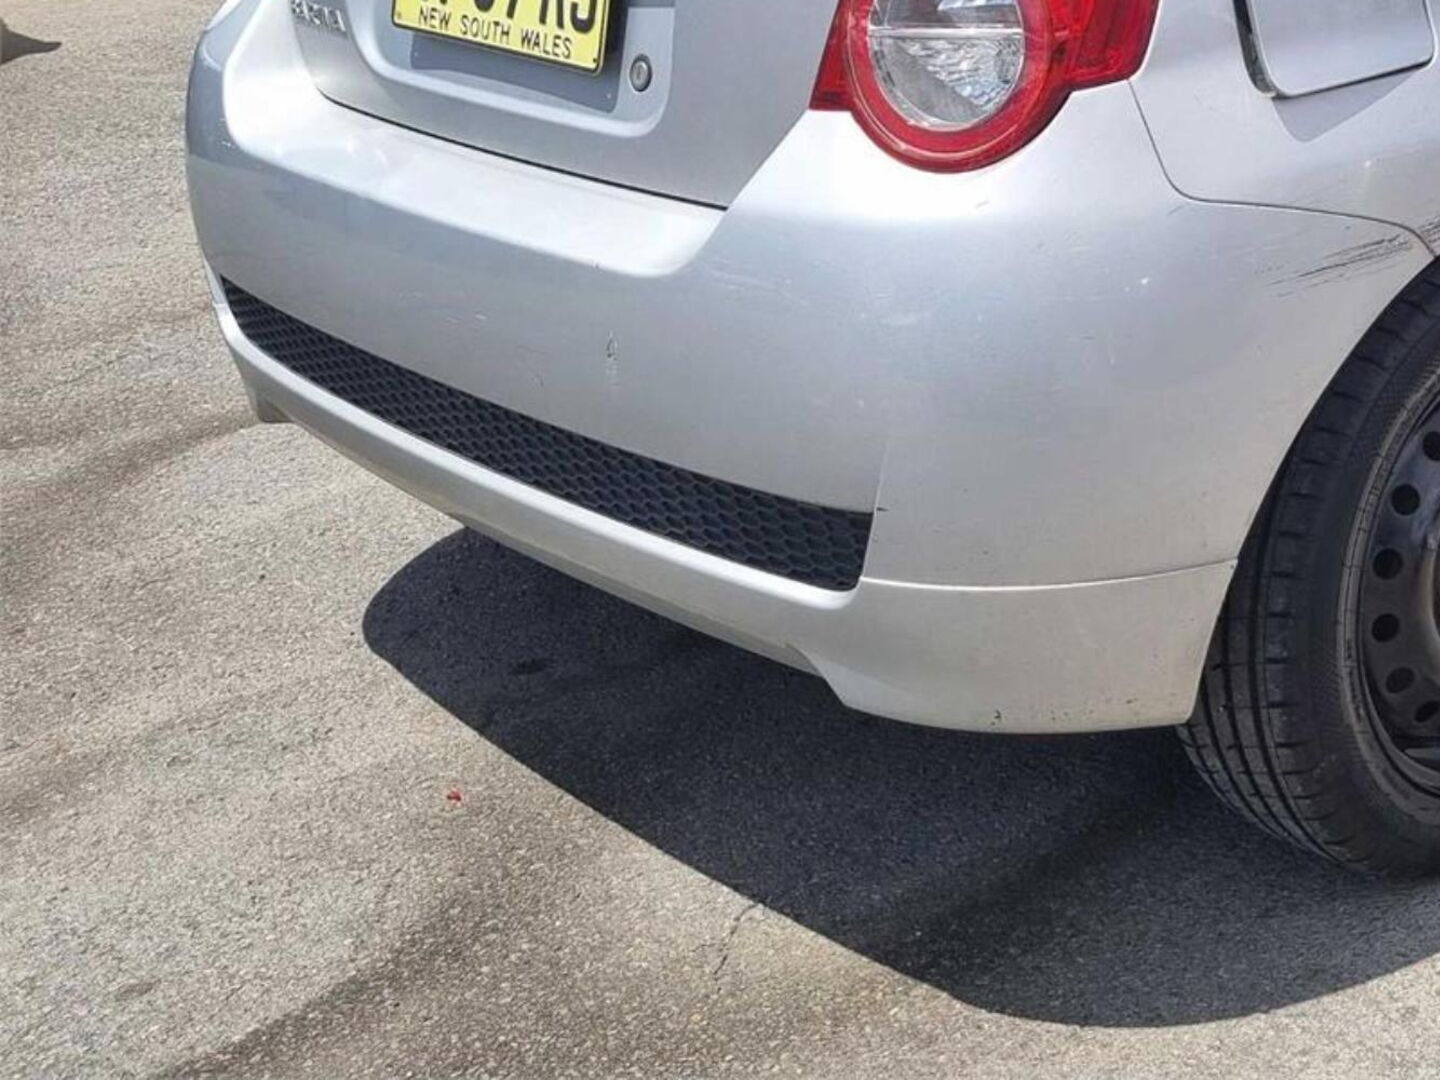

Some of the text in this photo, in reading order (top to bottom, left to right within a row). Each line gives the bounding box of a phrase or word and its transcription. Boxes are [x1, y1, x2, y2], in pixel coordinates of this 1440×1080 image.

[418, 4, 573, 60] NEW SOUTH WALES
